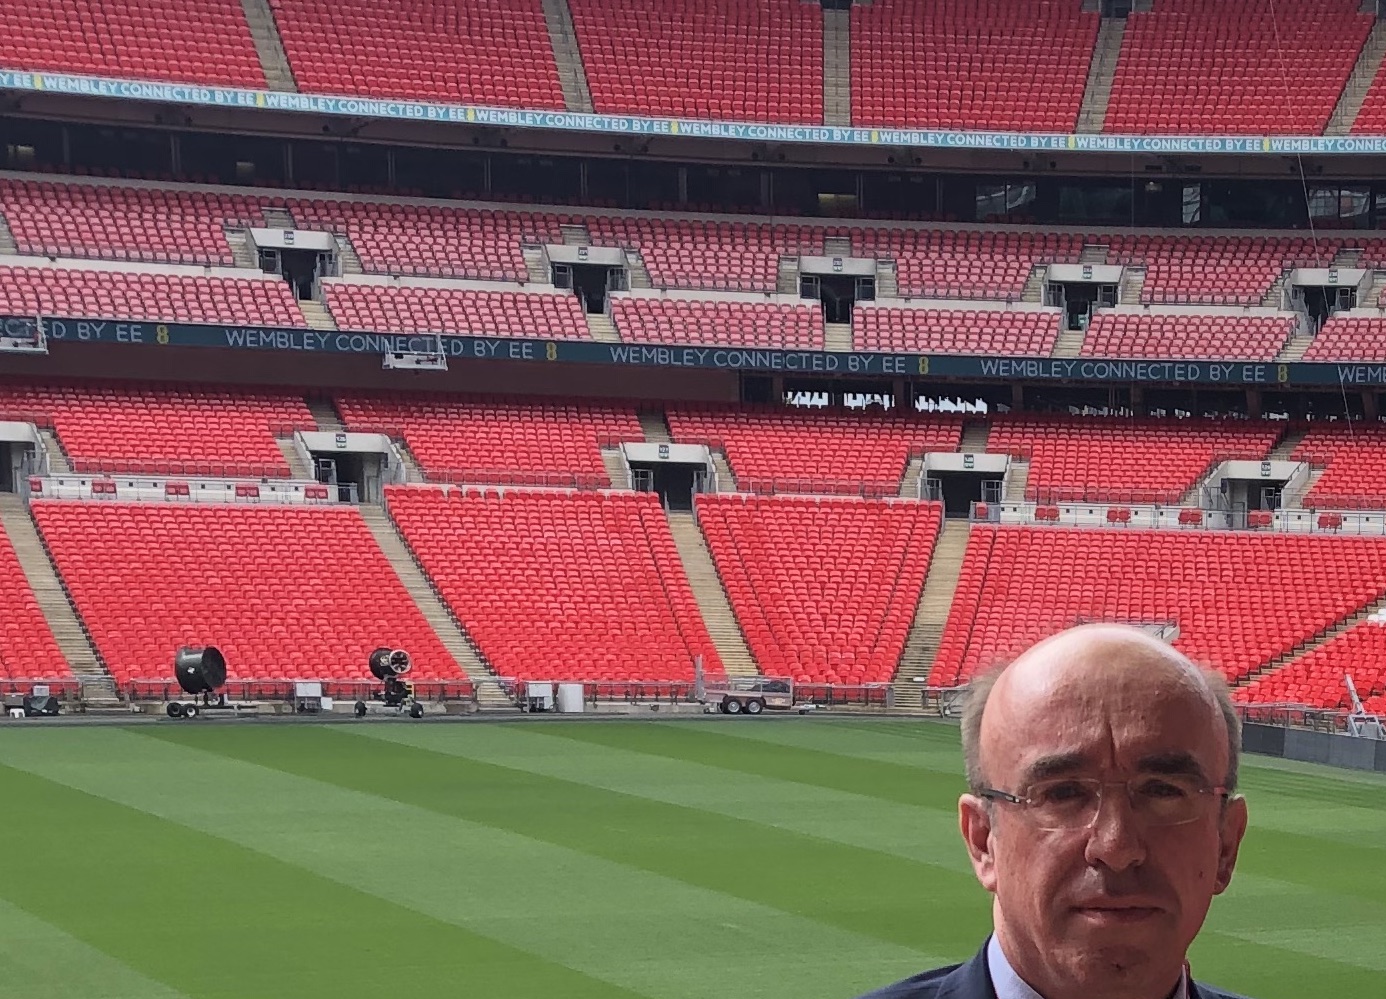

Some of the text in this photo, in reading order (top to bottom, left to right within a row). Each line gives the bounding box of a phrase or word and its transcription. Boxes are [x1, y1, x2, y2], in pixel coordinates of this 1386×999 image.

[13, 74, 30, 88] EE
[44, 77, 254, 106] WEMBLEY CONNECTED BY EE
[265, 94, 465, 121] WEMBLEY CONNECTED BY EE
[476, 109, 669, 133] WEMBLEY CONNECTED BY EE
[679, 121, 868, 142] WEMBLEY CONNECTED BY EE
[880, 130, 1066, 148] WEMBLEY CONNECTED BY EE
[1076, 136, 1260, 151] WEMBLEY CONNECTED BY EE
[1272, 138, 1337, 151] WEMBLEY
[78, 322, 105, 340] BY
[116, 324, 142, 343] EE
[226, 329, 330, 350] WEMBLEY
[474, 340, 501, 357] BY
[509, 342, 534, 360] EE
[609, 347, 709, 366] WEMBLEY
[714, 350, 838, 371] CONNECTED
[848, 355, 875, 372] BY
[883, 357, 906, 373] EE
[980, 358, 1076, 377] WEMBLEY
[1081, 361, 1200, 380] CONNECTED
[1209, 363, 1234, 381] BY
[1242, 364, 1265, 382] EE
